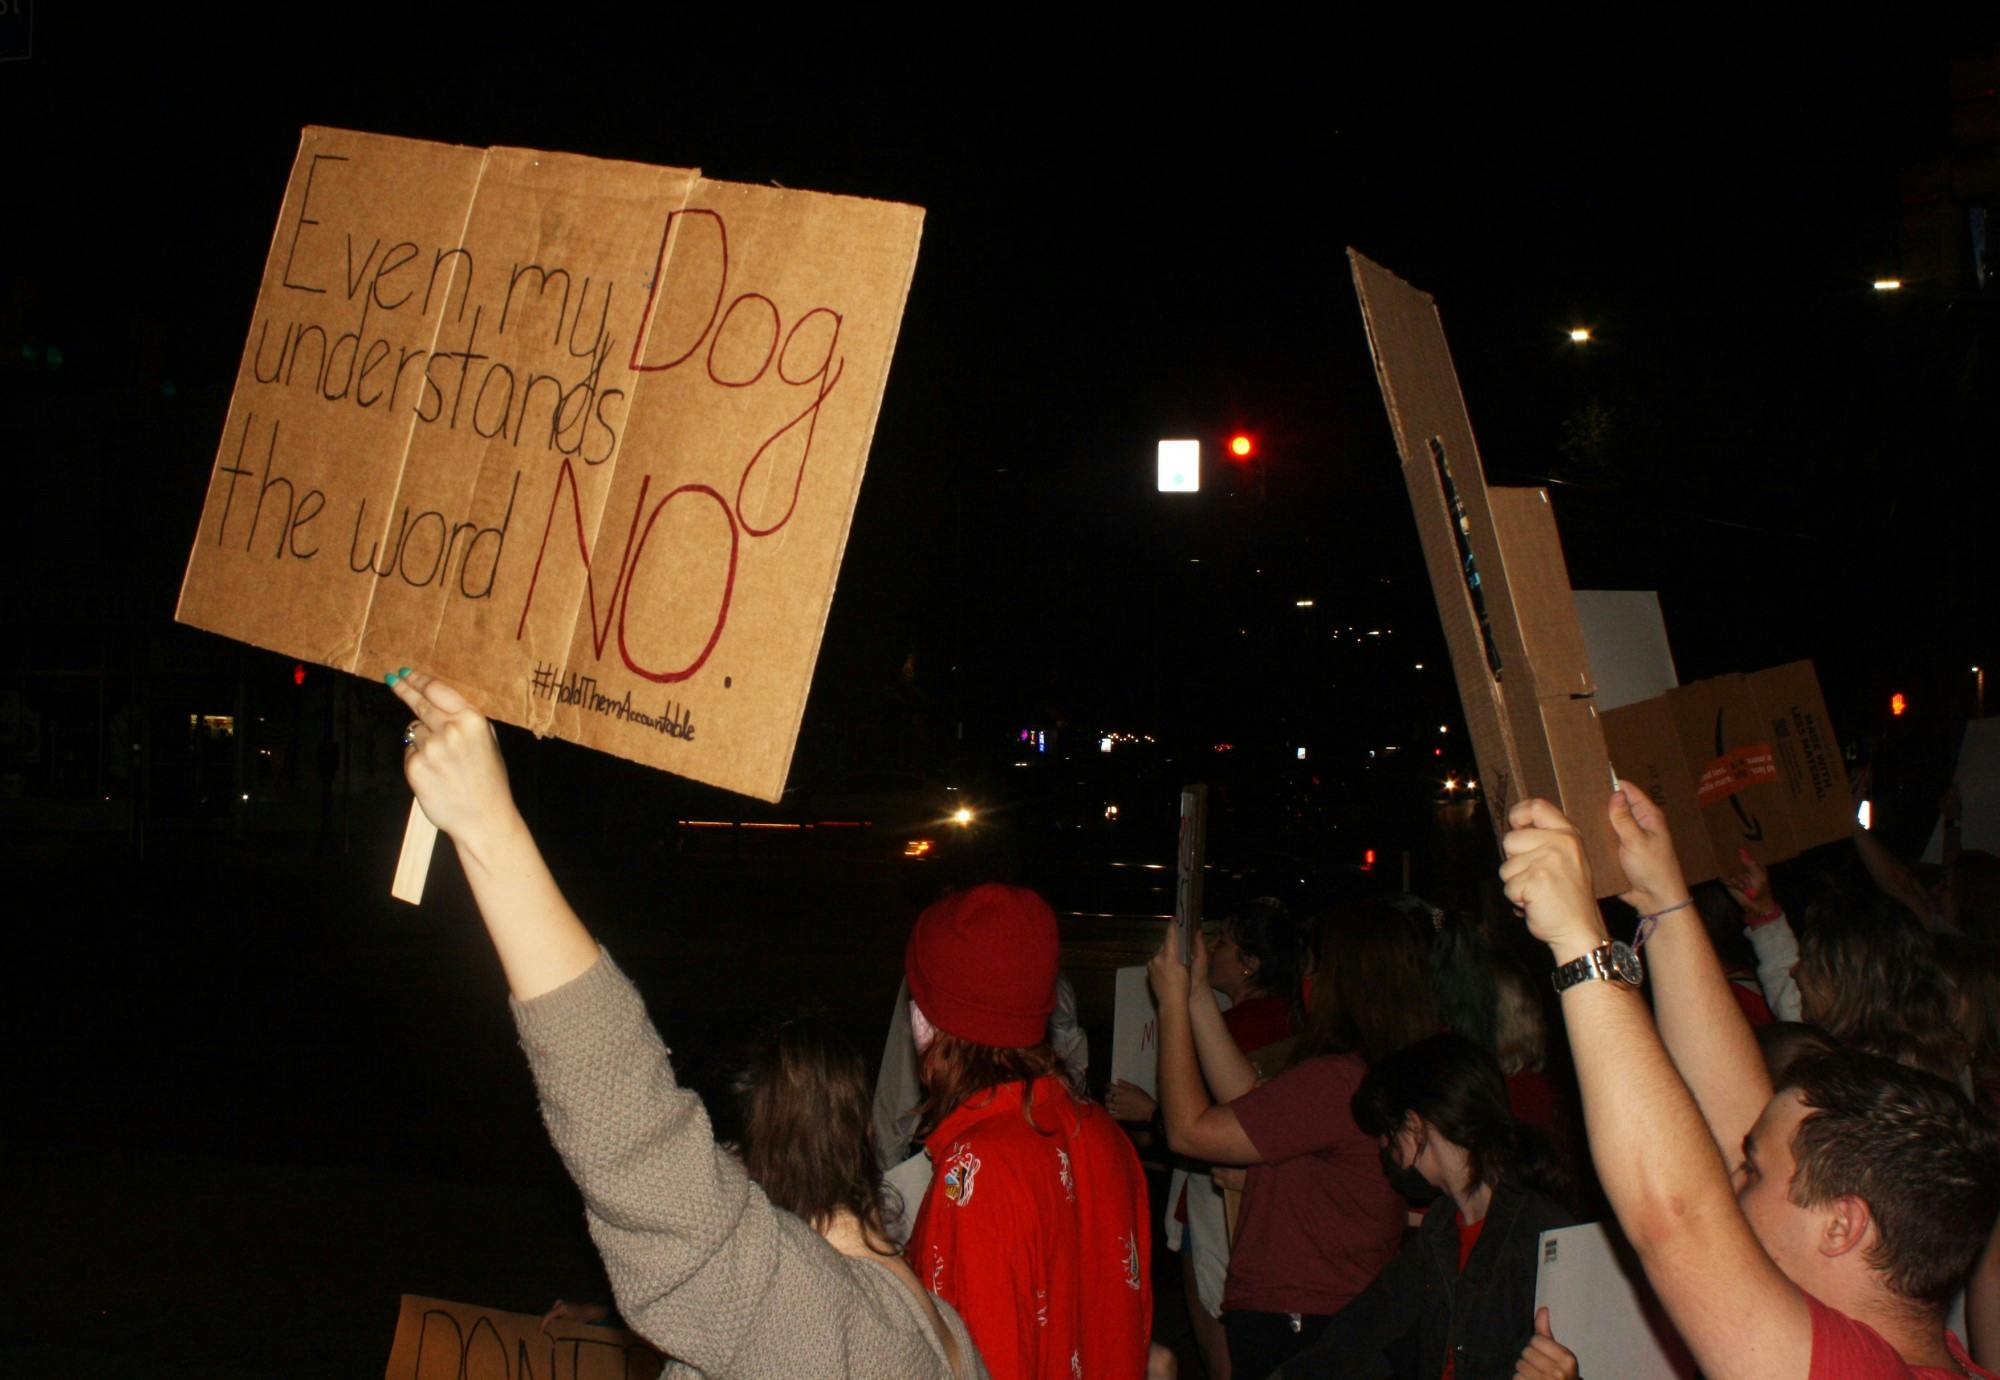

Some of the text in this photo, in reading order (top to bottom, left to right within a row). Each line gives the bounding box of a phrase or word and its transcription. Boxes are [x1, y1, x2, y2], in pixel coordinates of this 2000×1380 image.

[253, 280, 627, 467] understands
[628, 208, 845, 539] Dog
[218, 411, 327, 560] the
[349, 469, 522, 600] word
[531, 660, 696, 742] #HoldThemAccountable
[1791, 704, 1826, 801] LESS MATERIAL
[1805, 713, 1833, 788] MADE WITH
